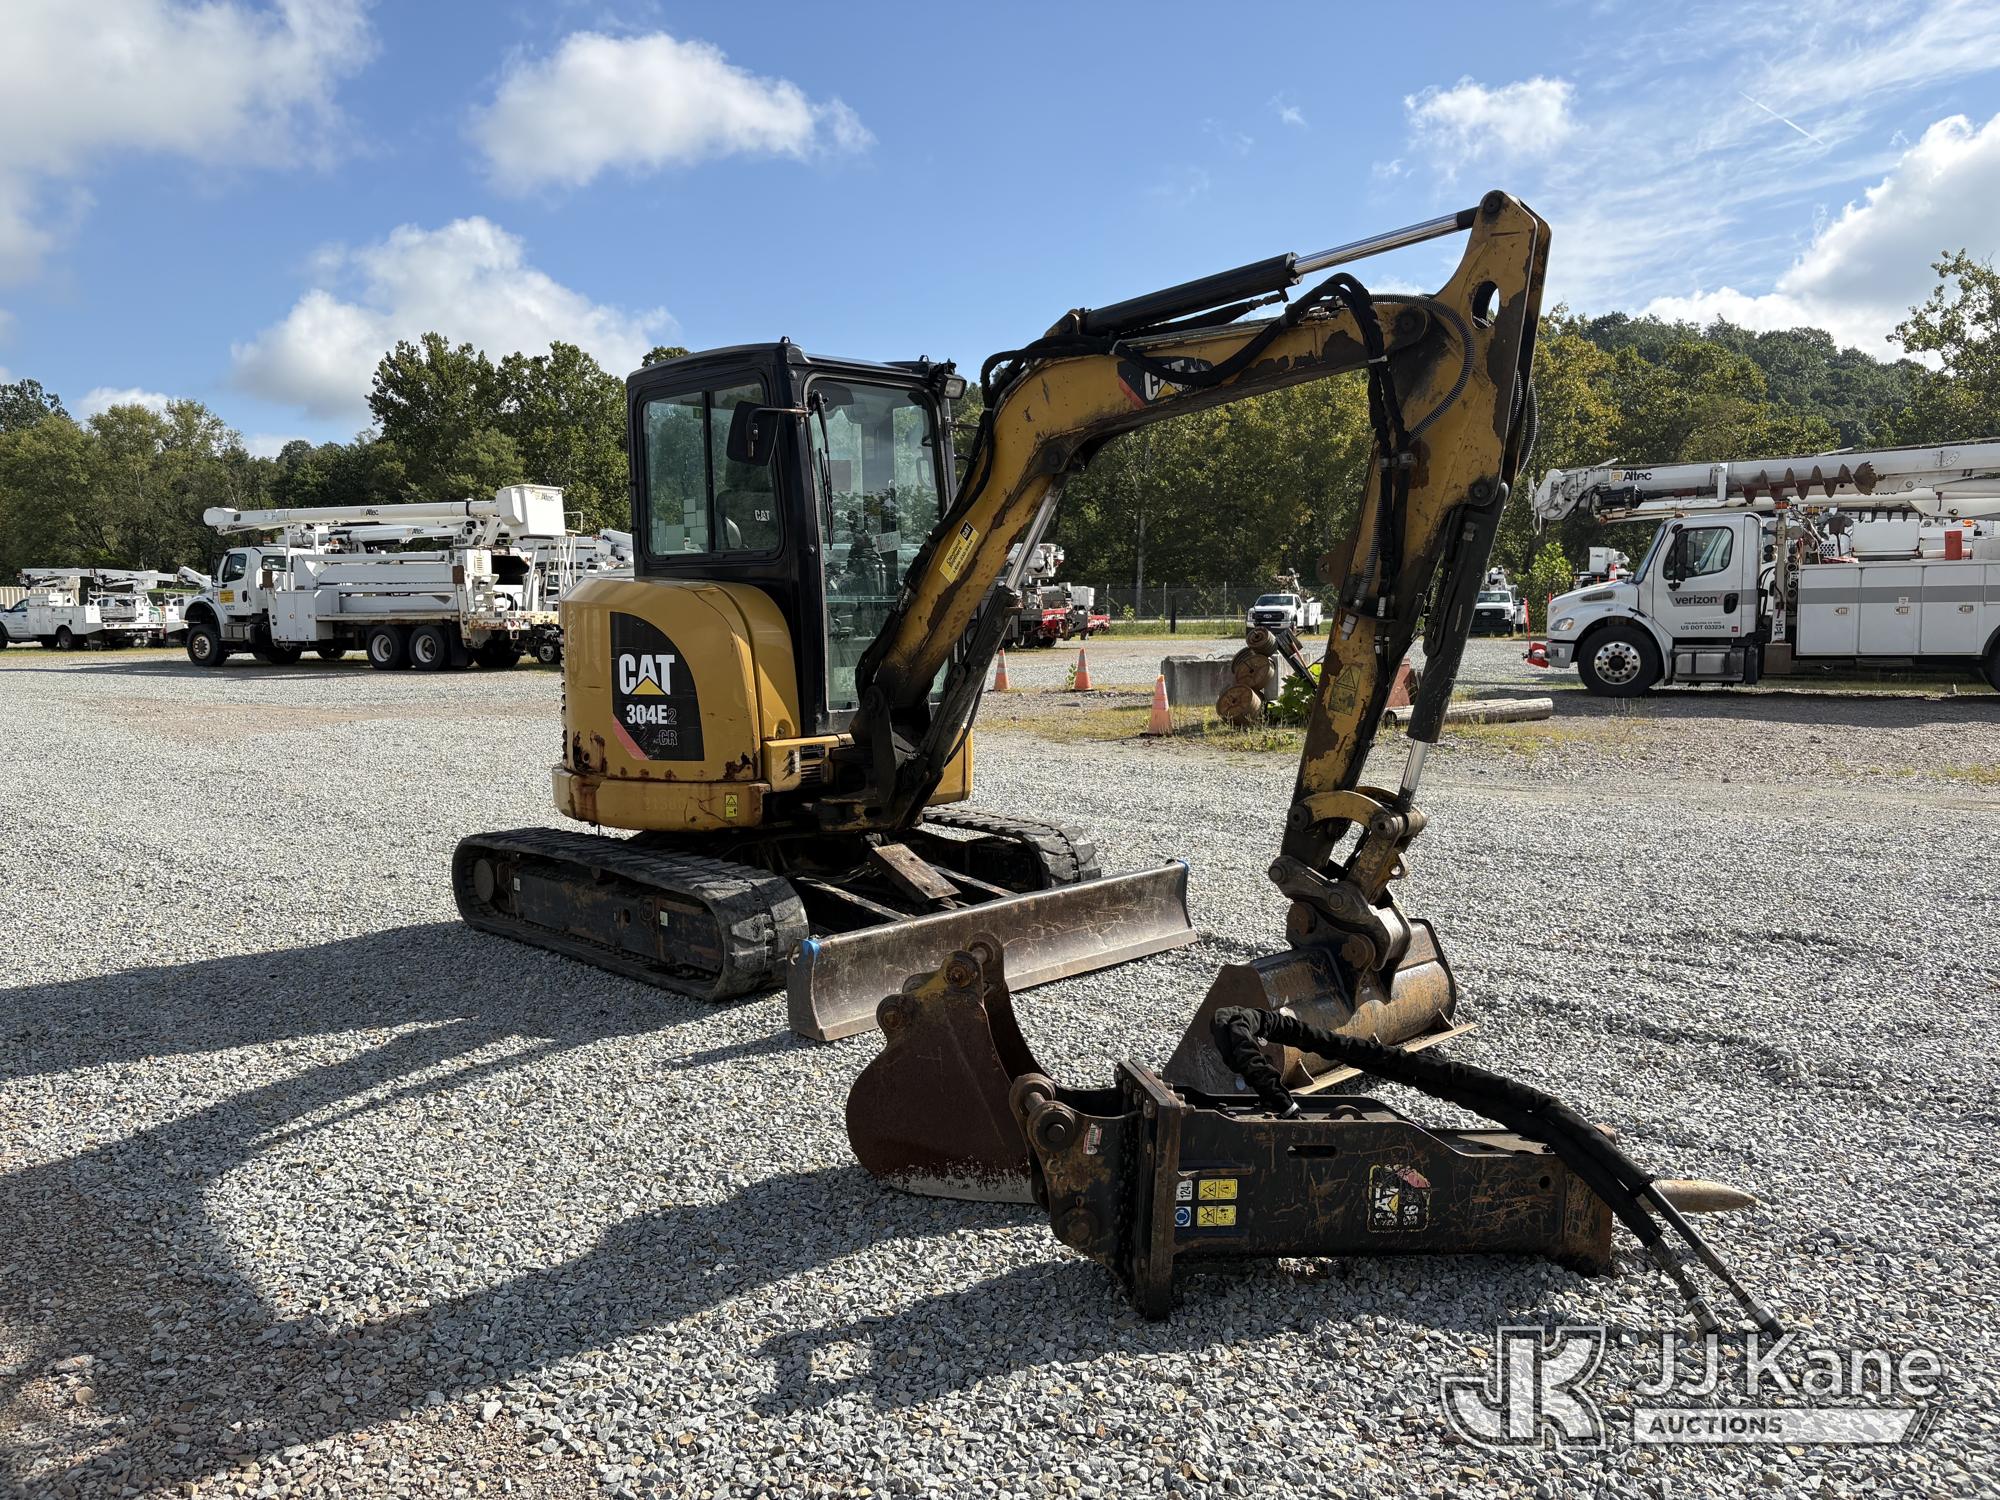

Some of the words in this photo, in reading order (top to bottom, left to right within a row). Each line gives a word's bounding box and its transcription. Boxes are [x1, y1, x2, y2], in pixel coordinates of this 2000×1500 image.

[1623, 471, 1652, 481] Altec
[755, 509, 770, 521] CAT
[962, 524, 971, 538] CAT
[1675, 595, 1718, 604] verizon
[618, 653, 676, 695] CAT
[659, 729, 678, 746] CR
[1180, 1186, 1191, 1199] 124
